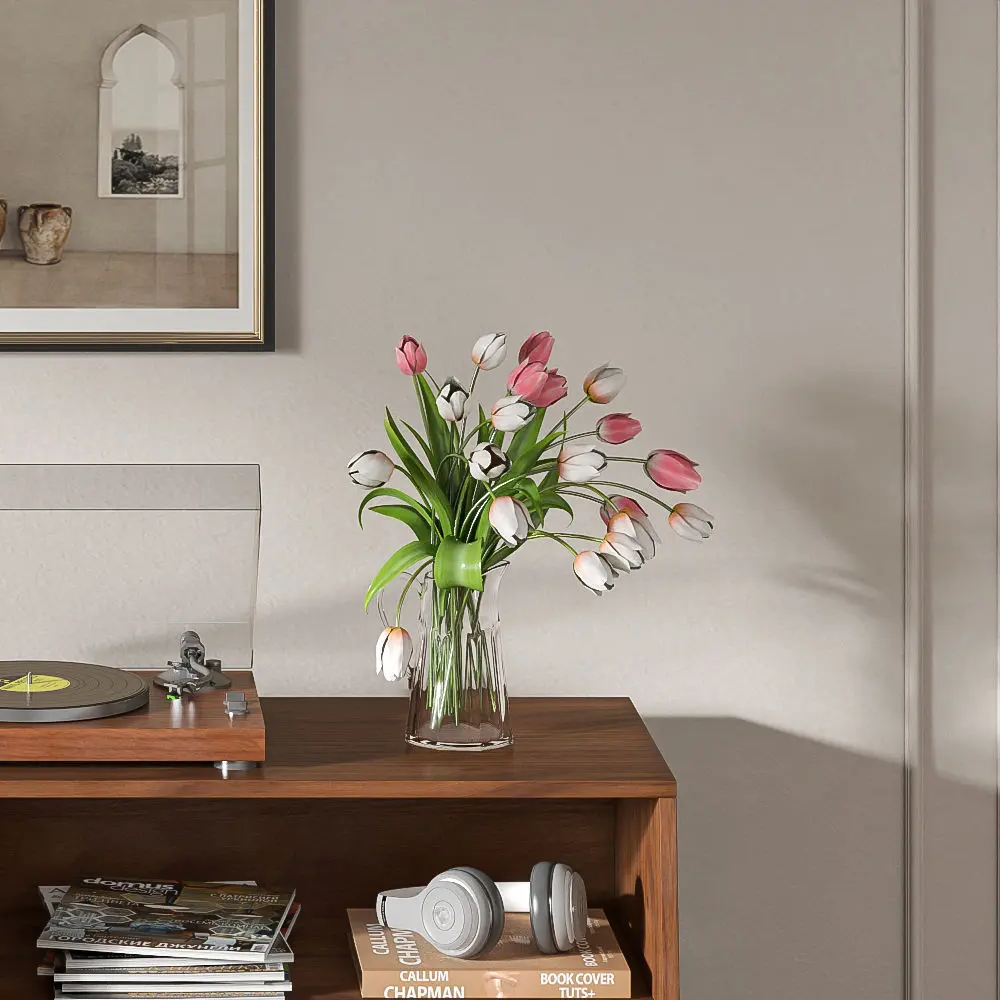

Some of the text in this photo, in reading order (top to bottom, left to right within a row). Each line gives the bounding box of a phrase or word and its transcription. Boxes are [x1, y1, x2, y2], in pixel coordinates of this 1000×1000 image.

[83, 878, 176, 891] domus
[109, 887, 179, 898] design
[400, 970, 448, 982] CALLUM
[540, 973, 615, 985] BOOK COVER
[384, 986, 464, 998] CHAPMAN
[559, 988, 595, 998] TUTS+
